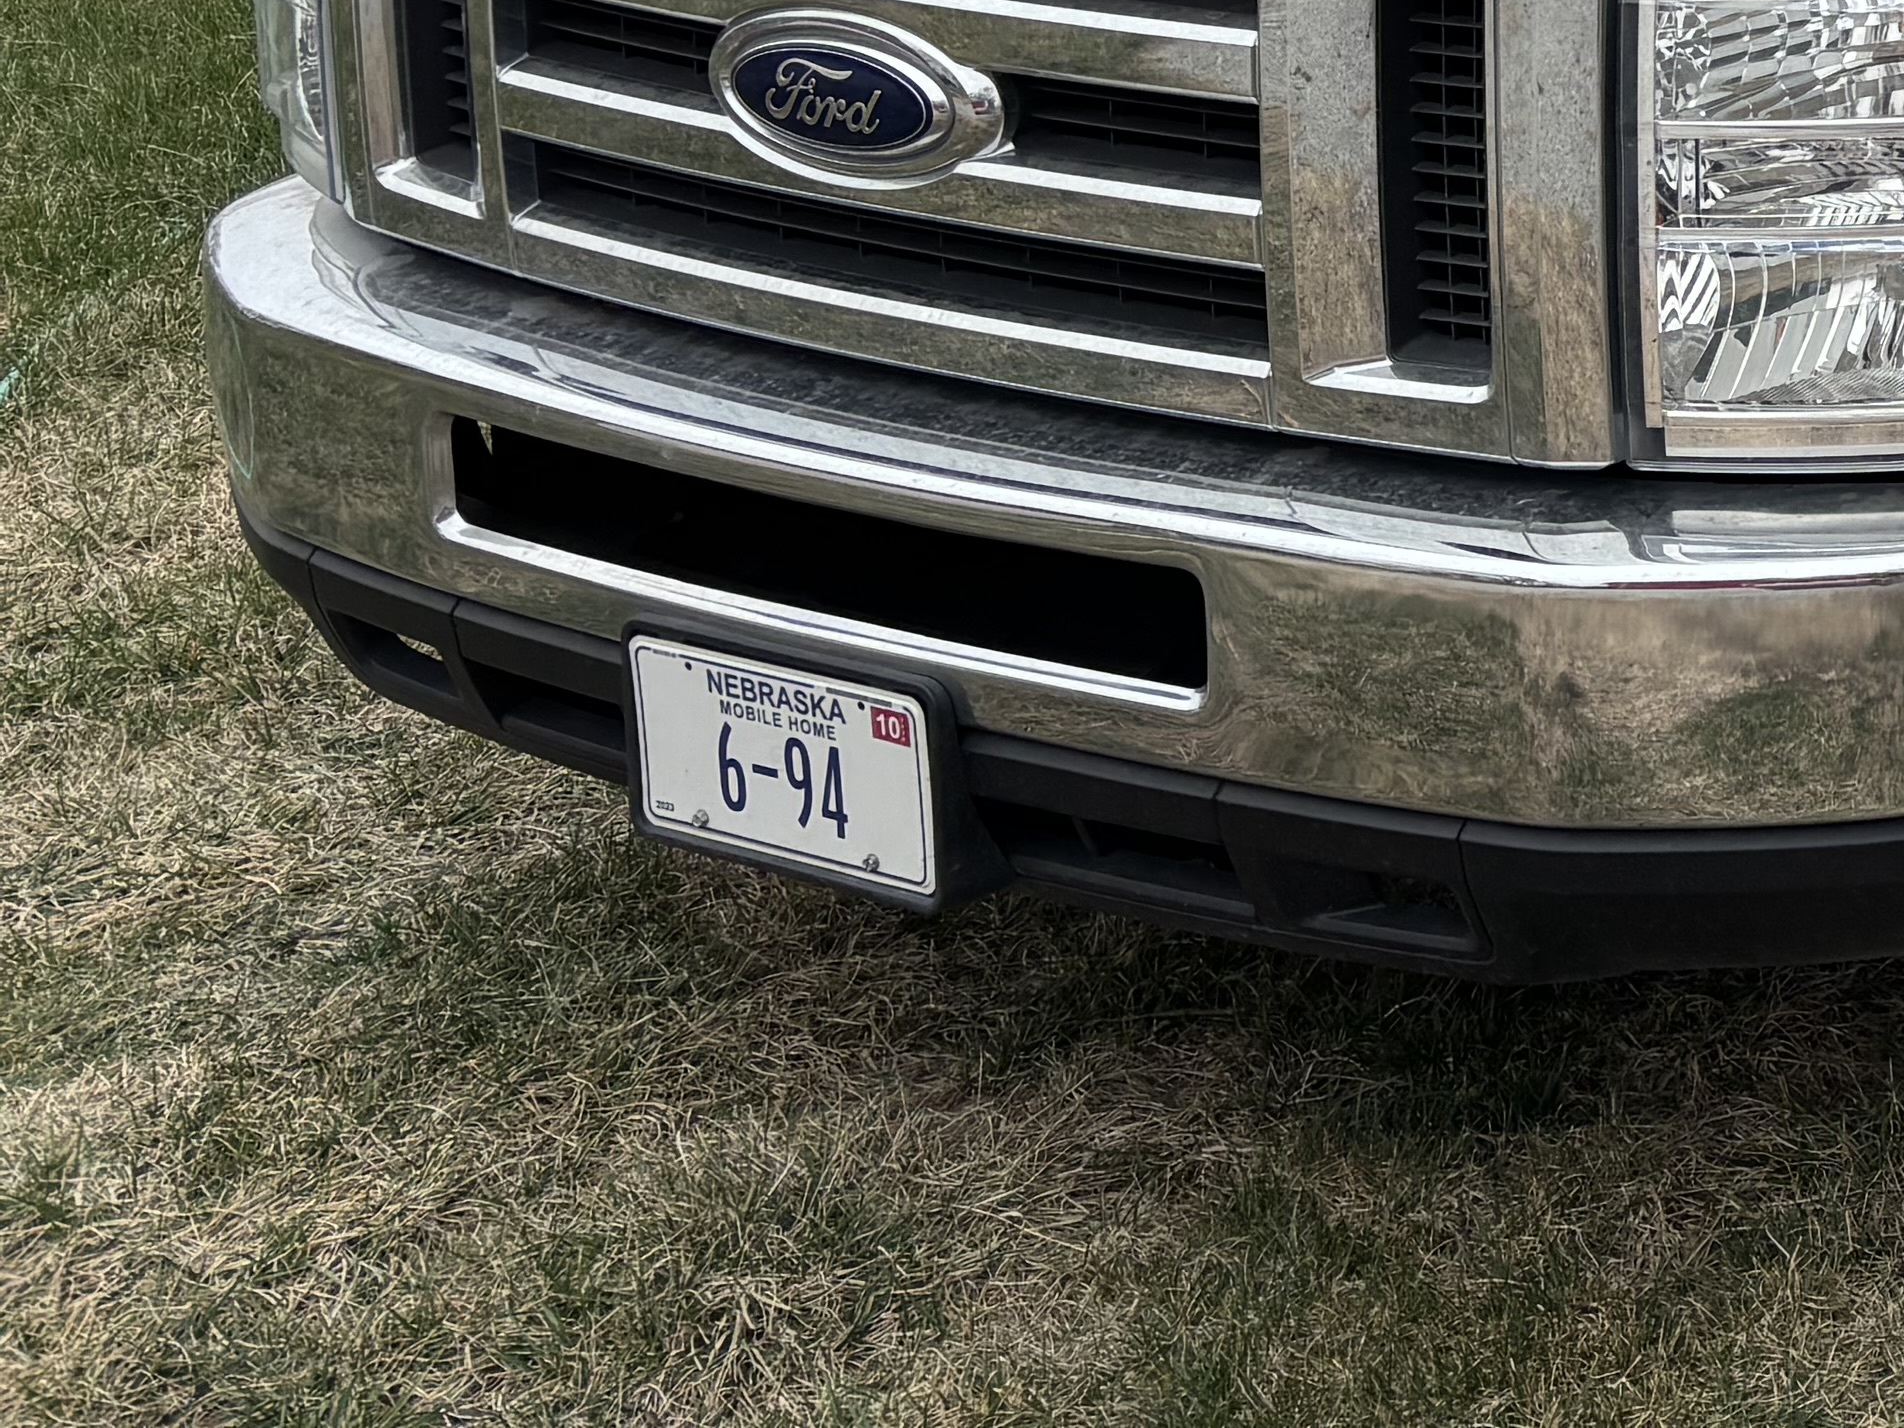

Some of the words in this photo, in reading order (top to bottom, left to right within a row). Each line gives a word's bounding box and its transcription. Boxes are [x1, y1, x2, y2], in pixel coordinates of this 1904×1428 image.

[765, 56, 882, 135] Ford
[706, 669, 847, 725] NEBRASKA
[719, 699, 783, 729] MOBILE
[788, 716, 838, 742] HOME
[875, 713, 902, 740] 10
[718, 721, 849, 839] 6-94
